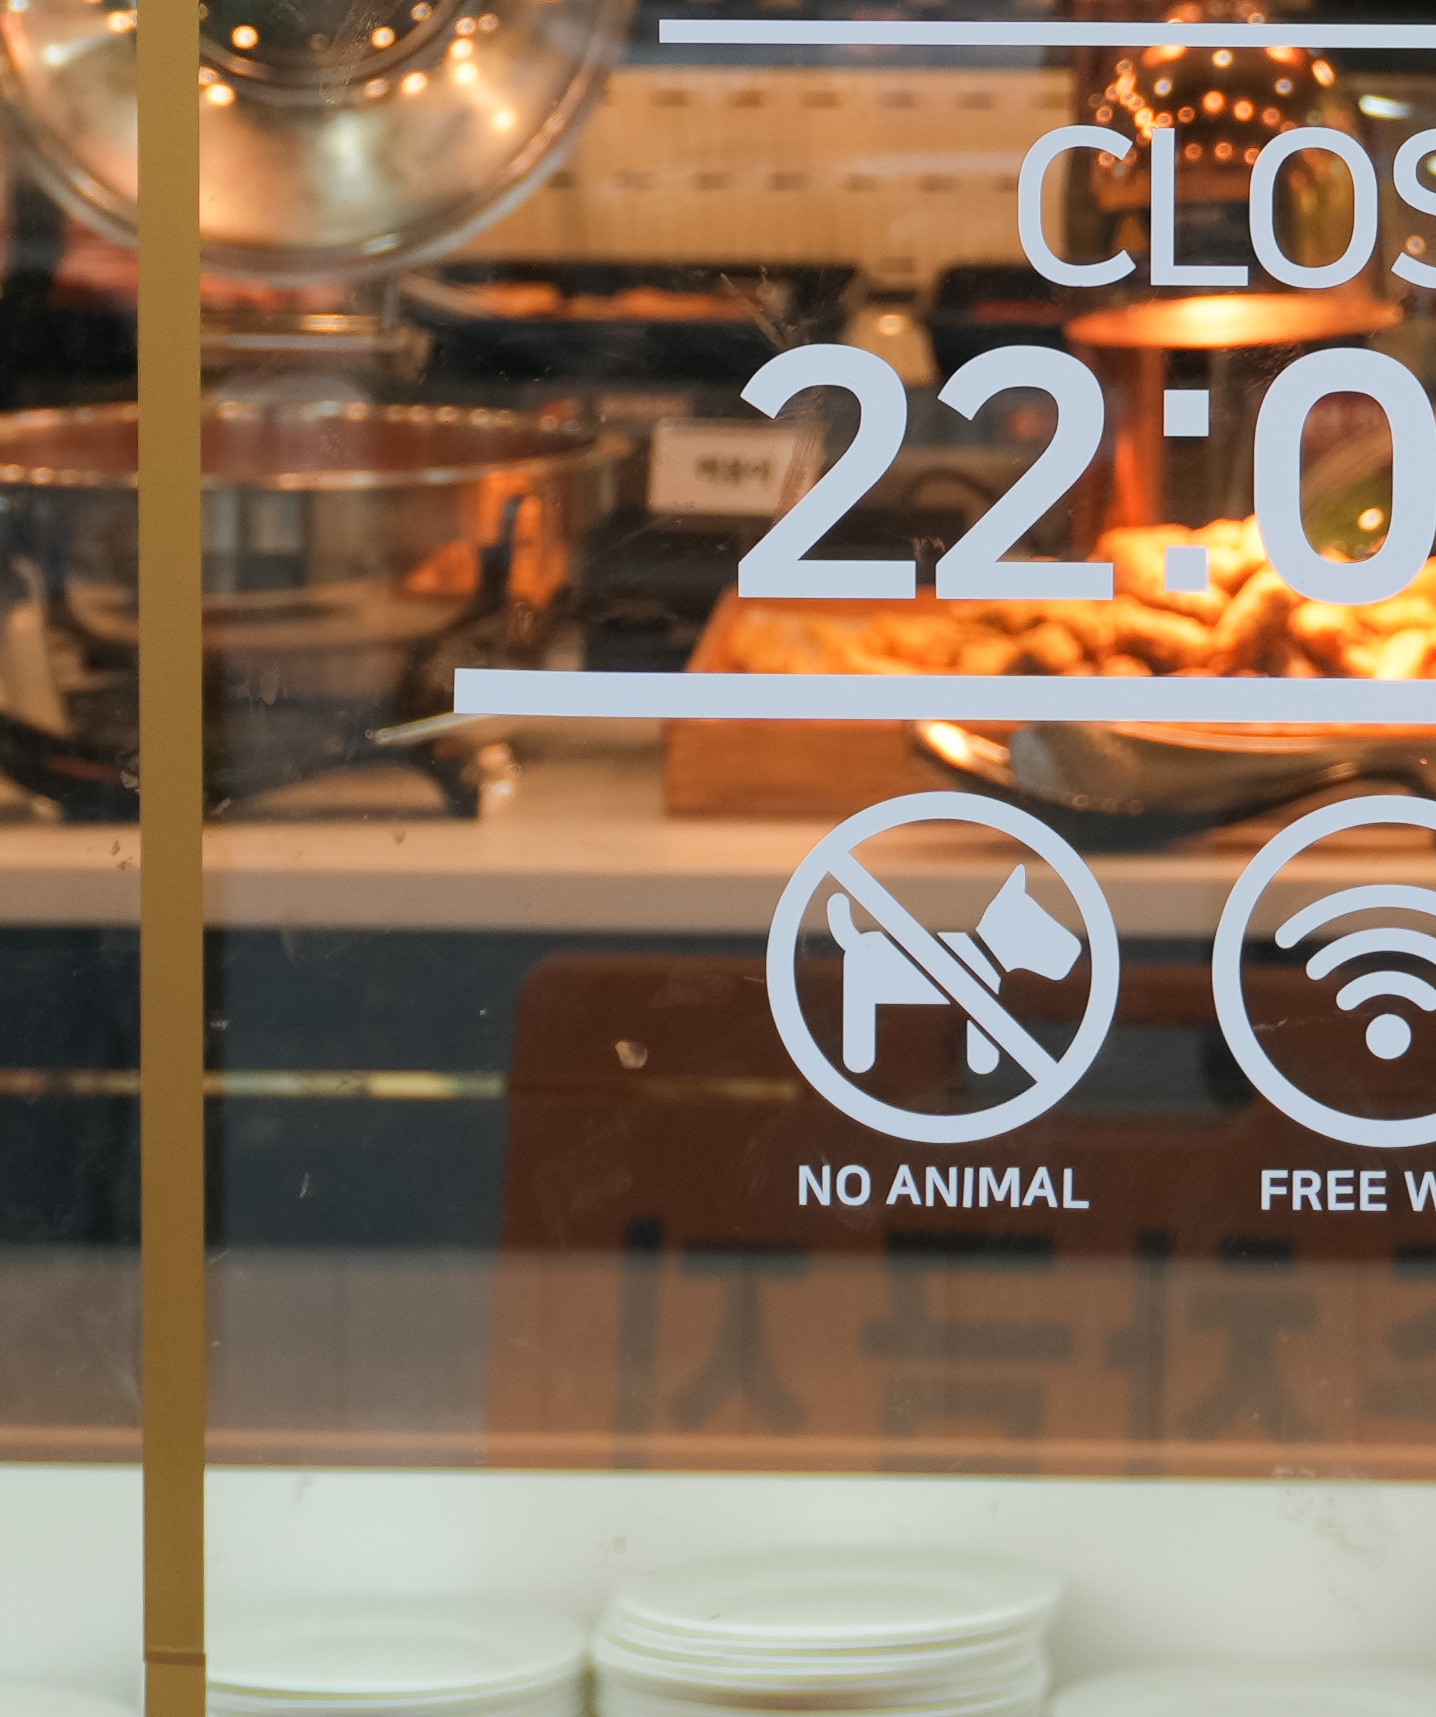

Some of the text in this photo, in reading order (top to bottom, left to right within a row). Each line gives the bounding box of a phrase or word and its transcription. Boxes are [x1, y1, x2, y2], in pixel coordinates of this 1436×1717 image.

[797, 1164, 1090, 1210] NO ANIMAL
[1260, 1169, 1388, 1212] FREE
